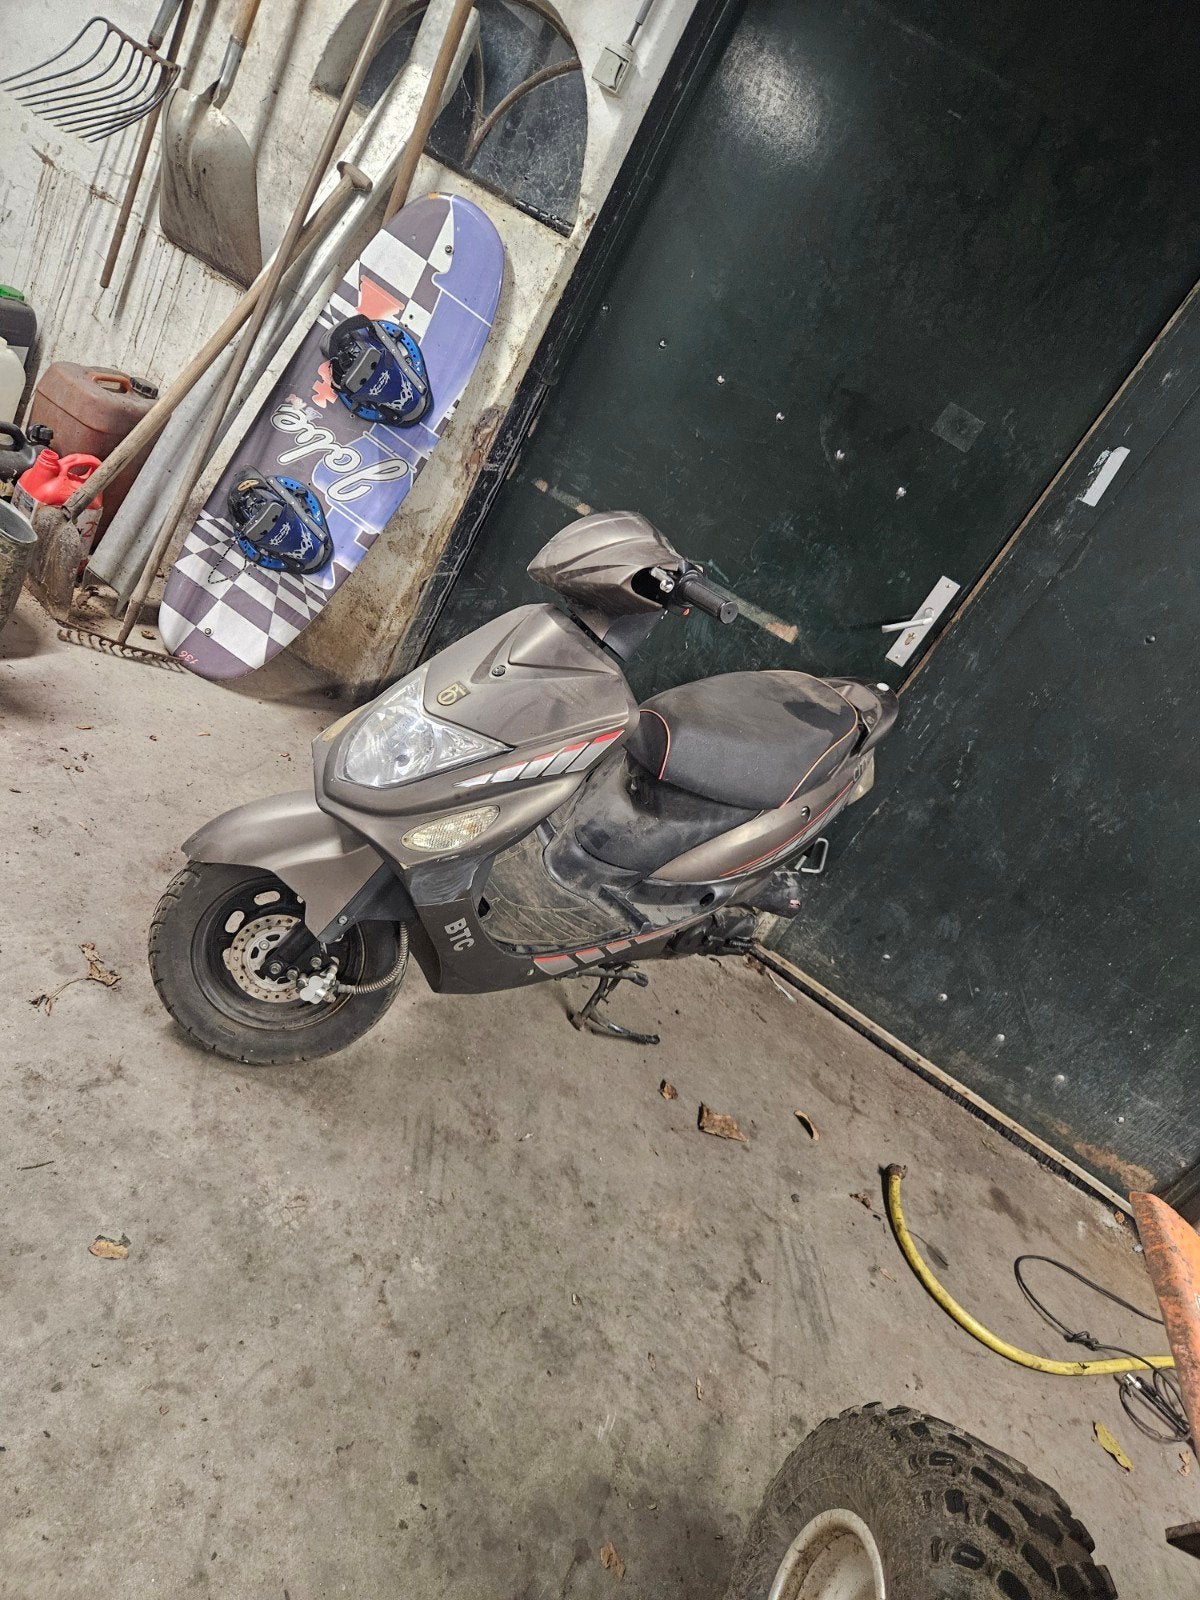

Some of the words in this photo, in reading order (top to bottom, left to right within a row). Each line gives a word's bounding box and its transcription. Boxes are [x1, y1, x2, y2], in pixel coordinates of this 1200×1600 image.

[271, 403, 411, 504] Jobe
[179, 650, 200, 666] 136
[444, 917, 475, 951] BTC
